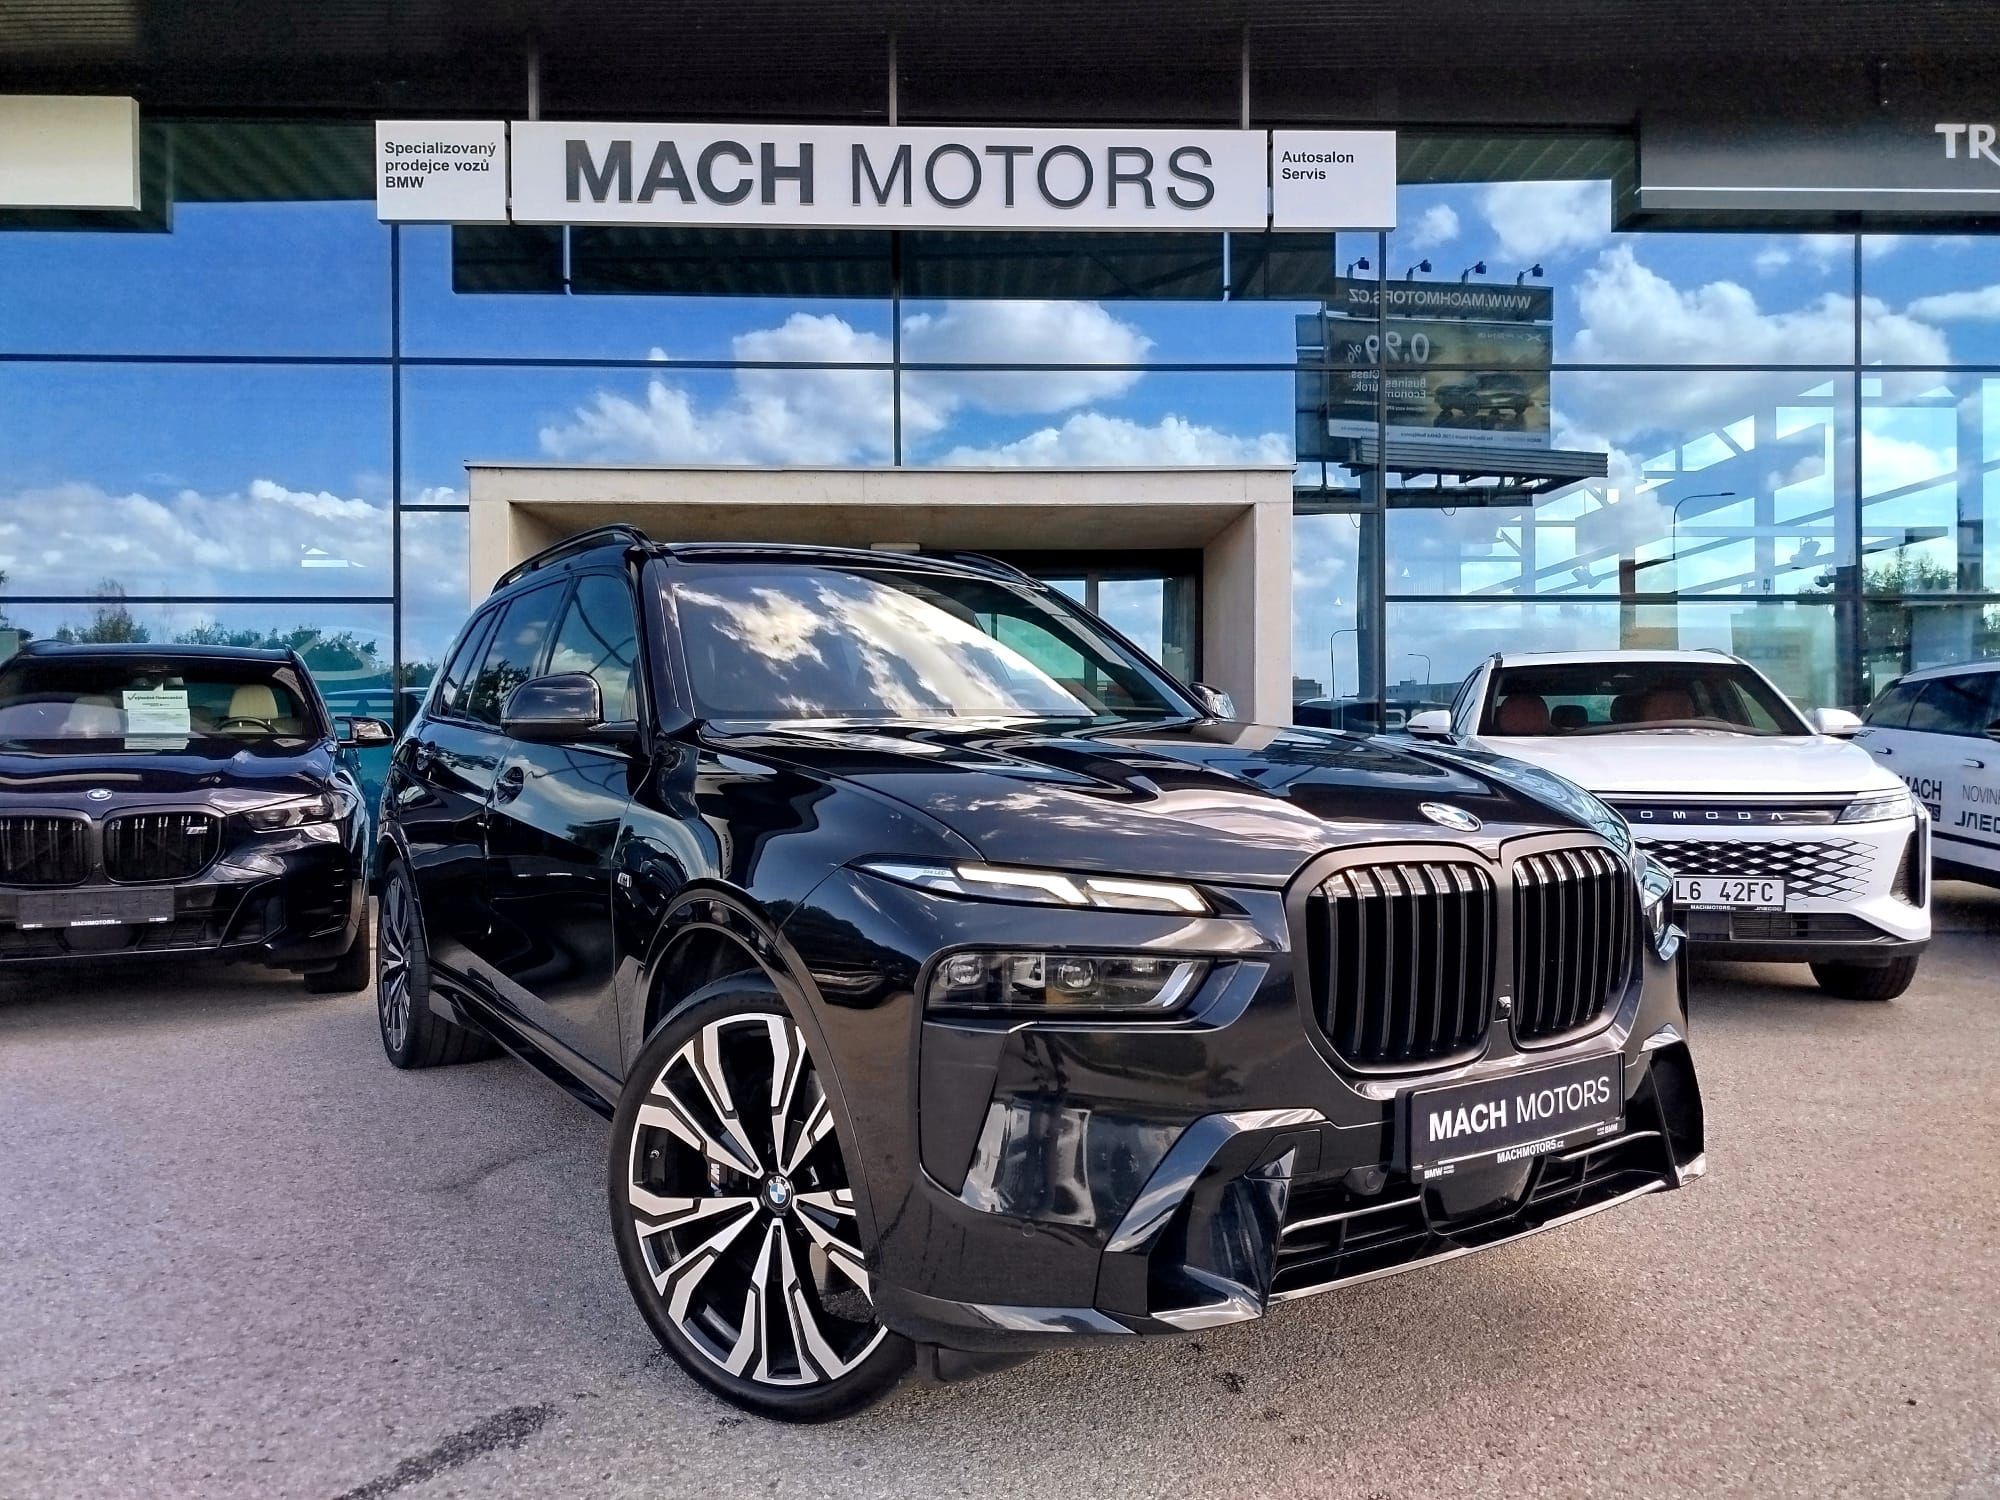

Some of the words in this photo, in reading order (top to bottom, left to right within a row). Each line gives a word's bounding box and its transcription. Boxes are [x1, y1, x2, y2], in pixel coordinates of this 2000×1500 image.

[385, 141, 496, 157] Specializovaný
[1935, 123, 2000, 167] TR
[1282, 151, 1354, 163] Autosalon
[385, 159, 449, 174] prodejce
[454, 159, 489, 171] vozů
[565, 139, 814, 206] MACH
[851, 143, 1215, 210] MOTORS
[1282, 168, 1326, 180] Servis
[385, 176, 424, 188] BMW
[1962, 784, 2000, 805] NOVIN
[1675, 880, 1702, 901] L6
[1720, 881, 1774, 902] 42FC
[1429, 1099, 1507, 1142] MACH
[1516, 1076, 1610, 1124] MOTORS
